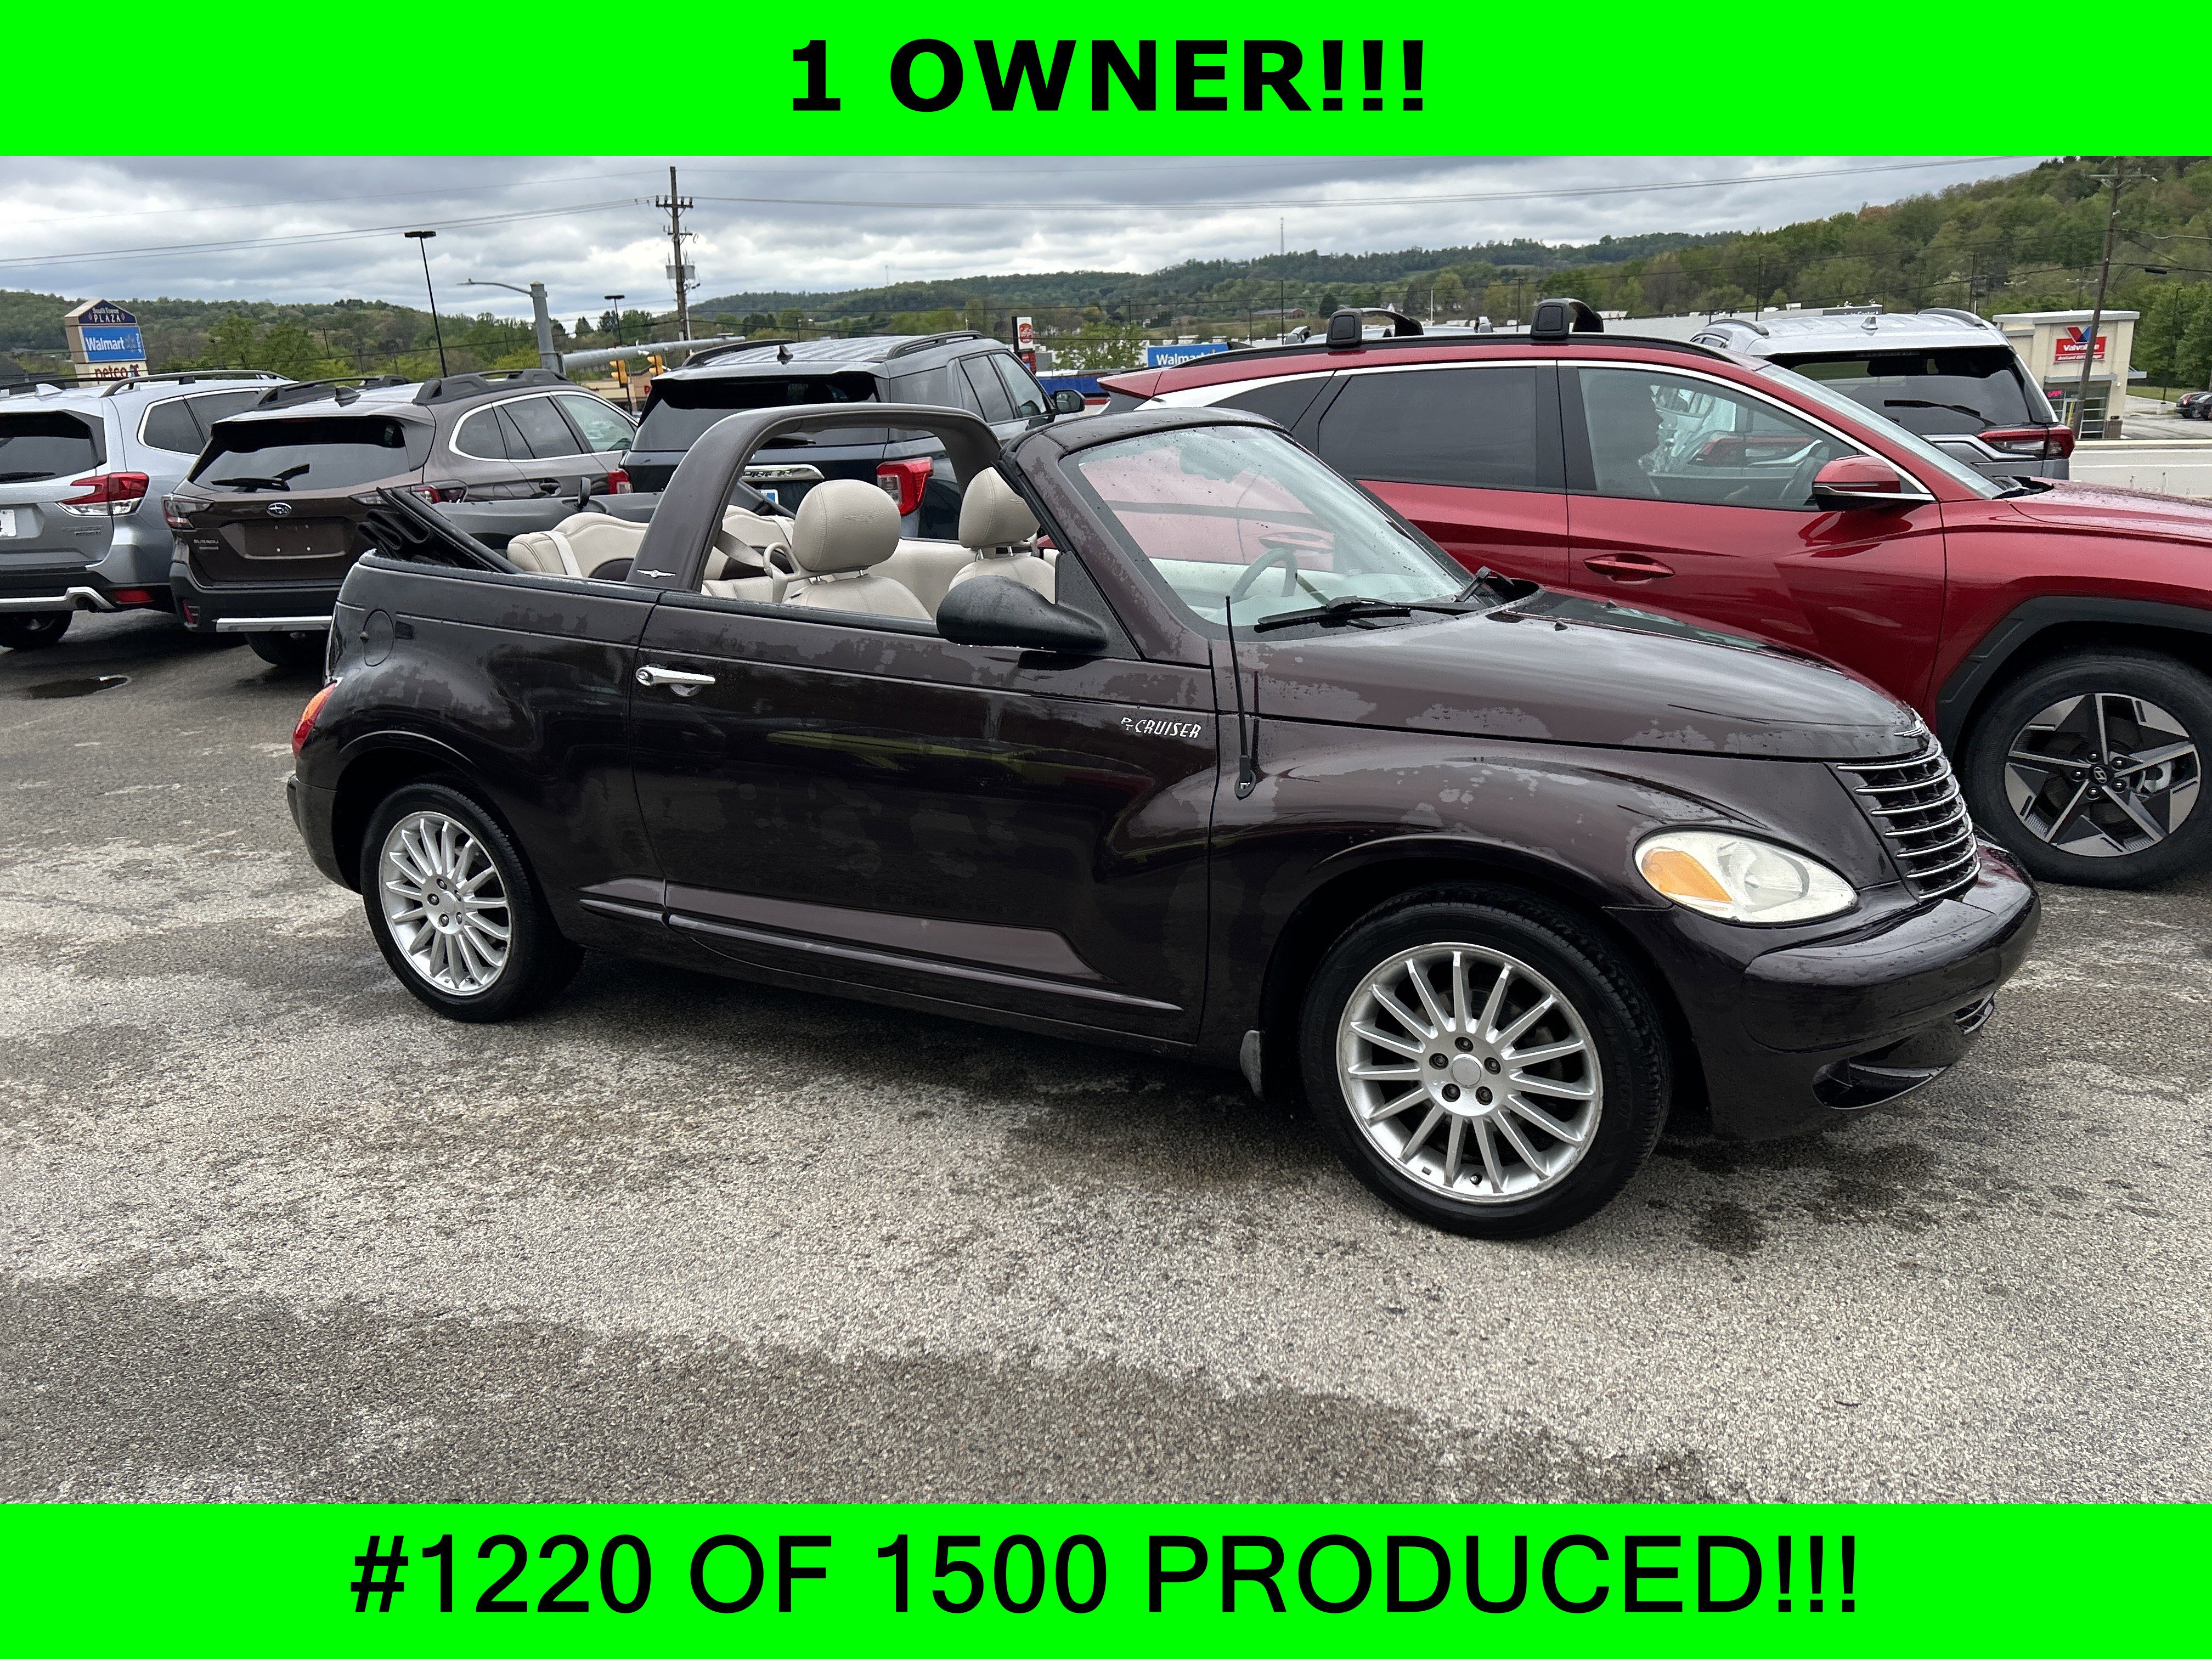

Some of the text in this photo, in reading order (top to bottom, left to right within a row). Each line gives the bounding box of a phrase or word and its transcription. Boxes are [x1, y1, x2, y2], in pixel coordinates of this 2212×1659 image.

[93, 314, 121, 323] PLAZA
[85, 336, 125, 351] Walmart
[1135, 719, 1201, 738] CRUISER
